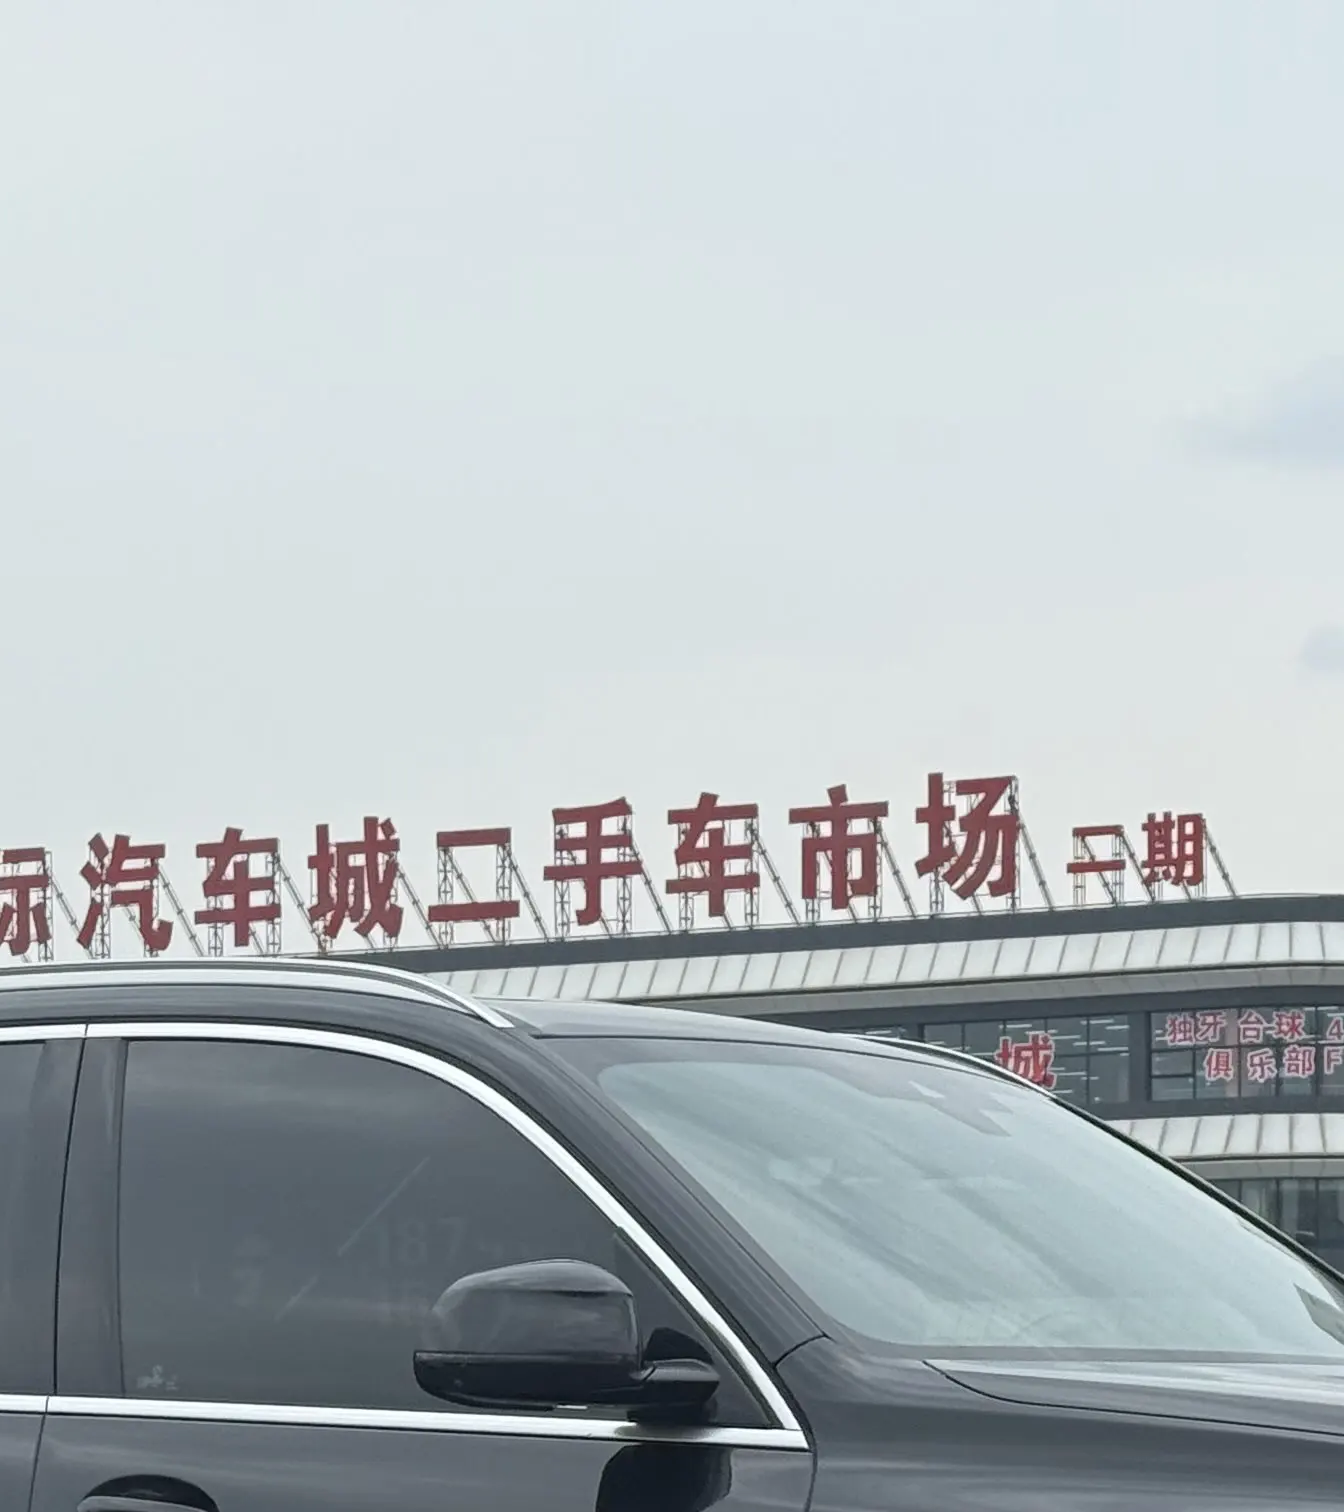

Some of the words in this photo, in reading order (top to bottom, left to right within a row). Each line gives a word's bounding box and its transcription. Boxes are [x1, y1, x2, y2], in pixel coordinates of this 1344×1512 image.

[1067, 812, 1206, 886] 二期
[995, 1032, 1056, 1090] 城
[1204, 1046, 1316, 1083] 俱乐部
